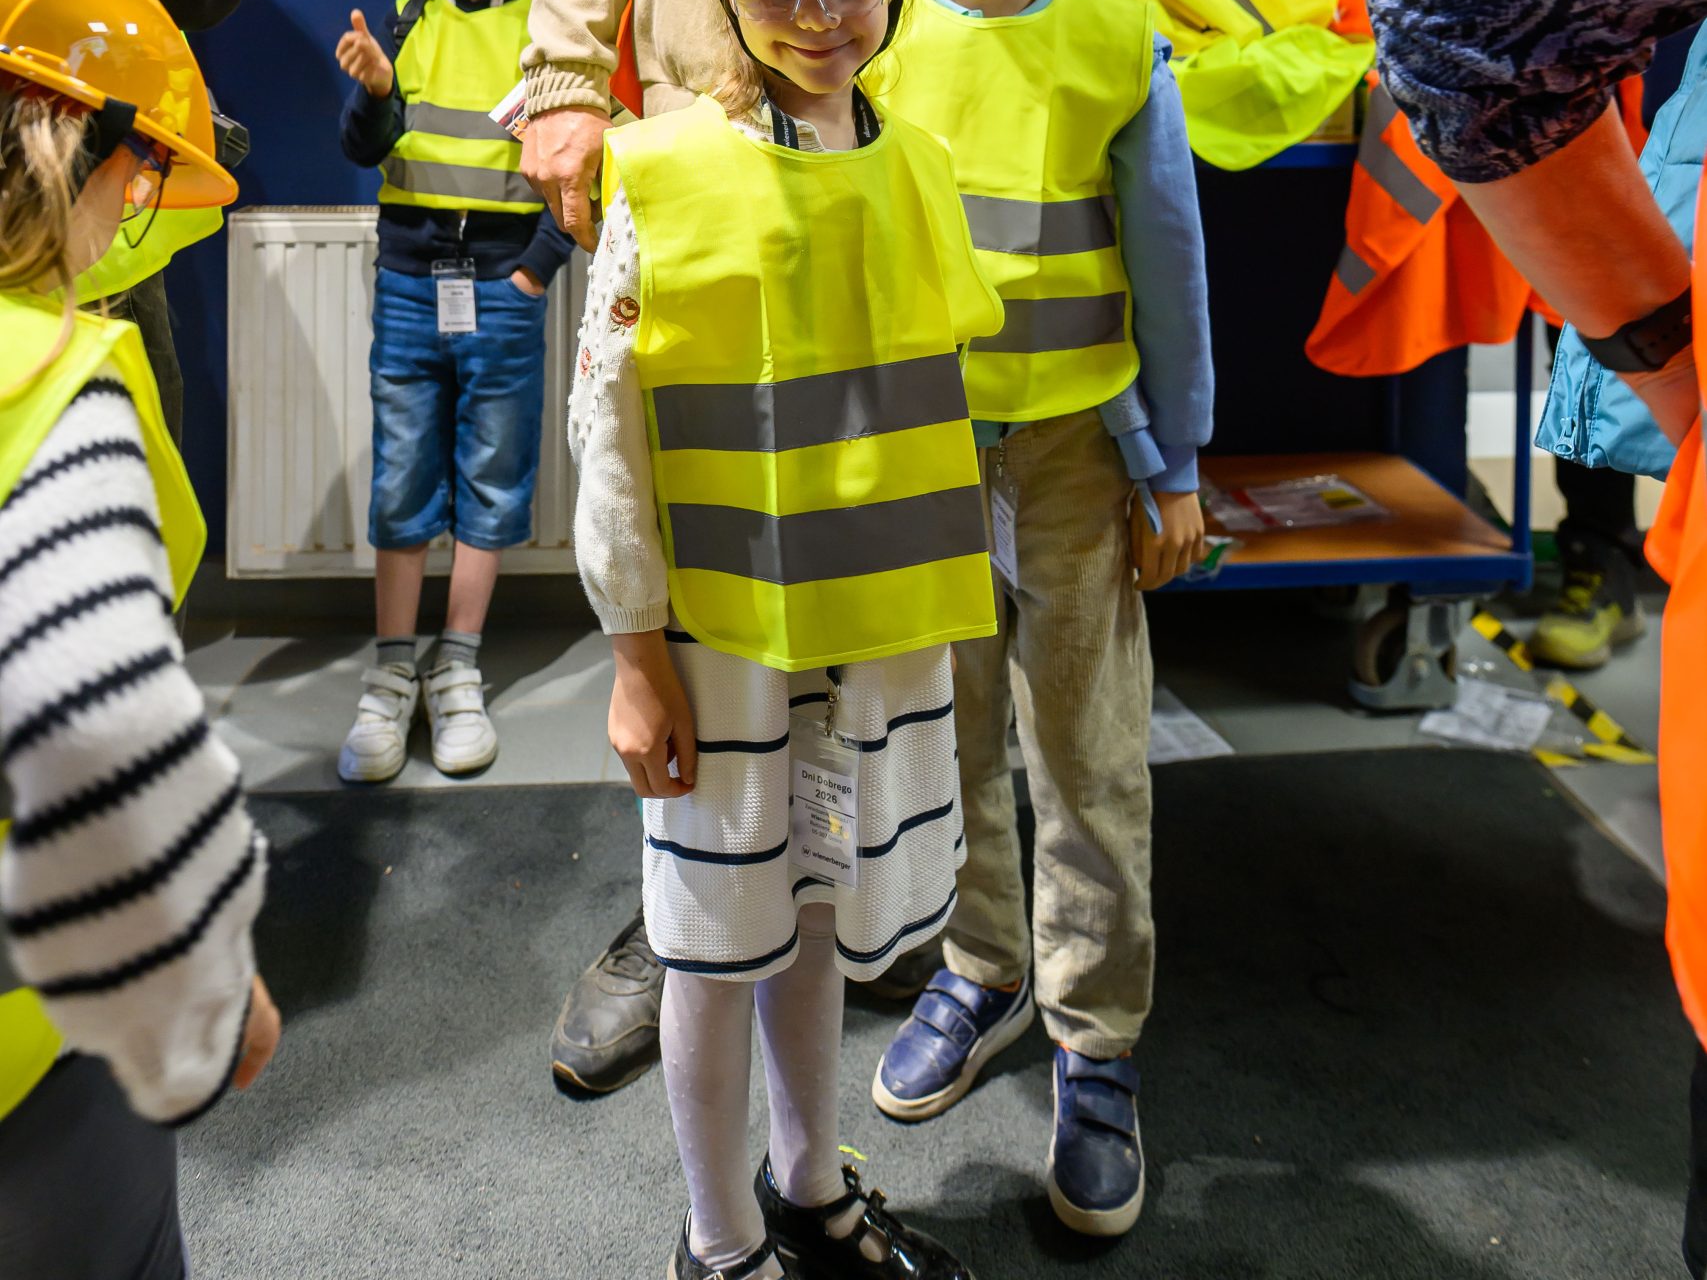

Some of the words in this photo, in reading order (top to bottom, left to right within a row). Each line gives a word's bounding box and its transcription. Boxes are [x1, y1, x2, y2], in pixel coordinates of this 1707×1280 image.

[817, 775, 852, 794] Dobrego
[815, 789, 838, 804] 2026
[812, 851, 851, 869] wienerberger
